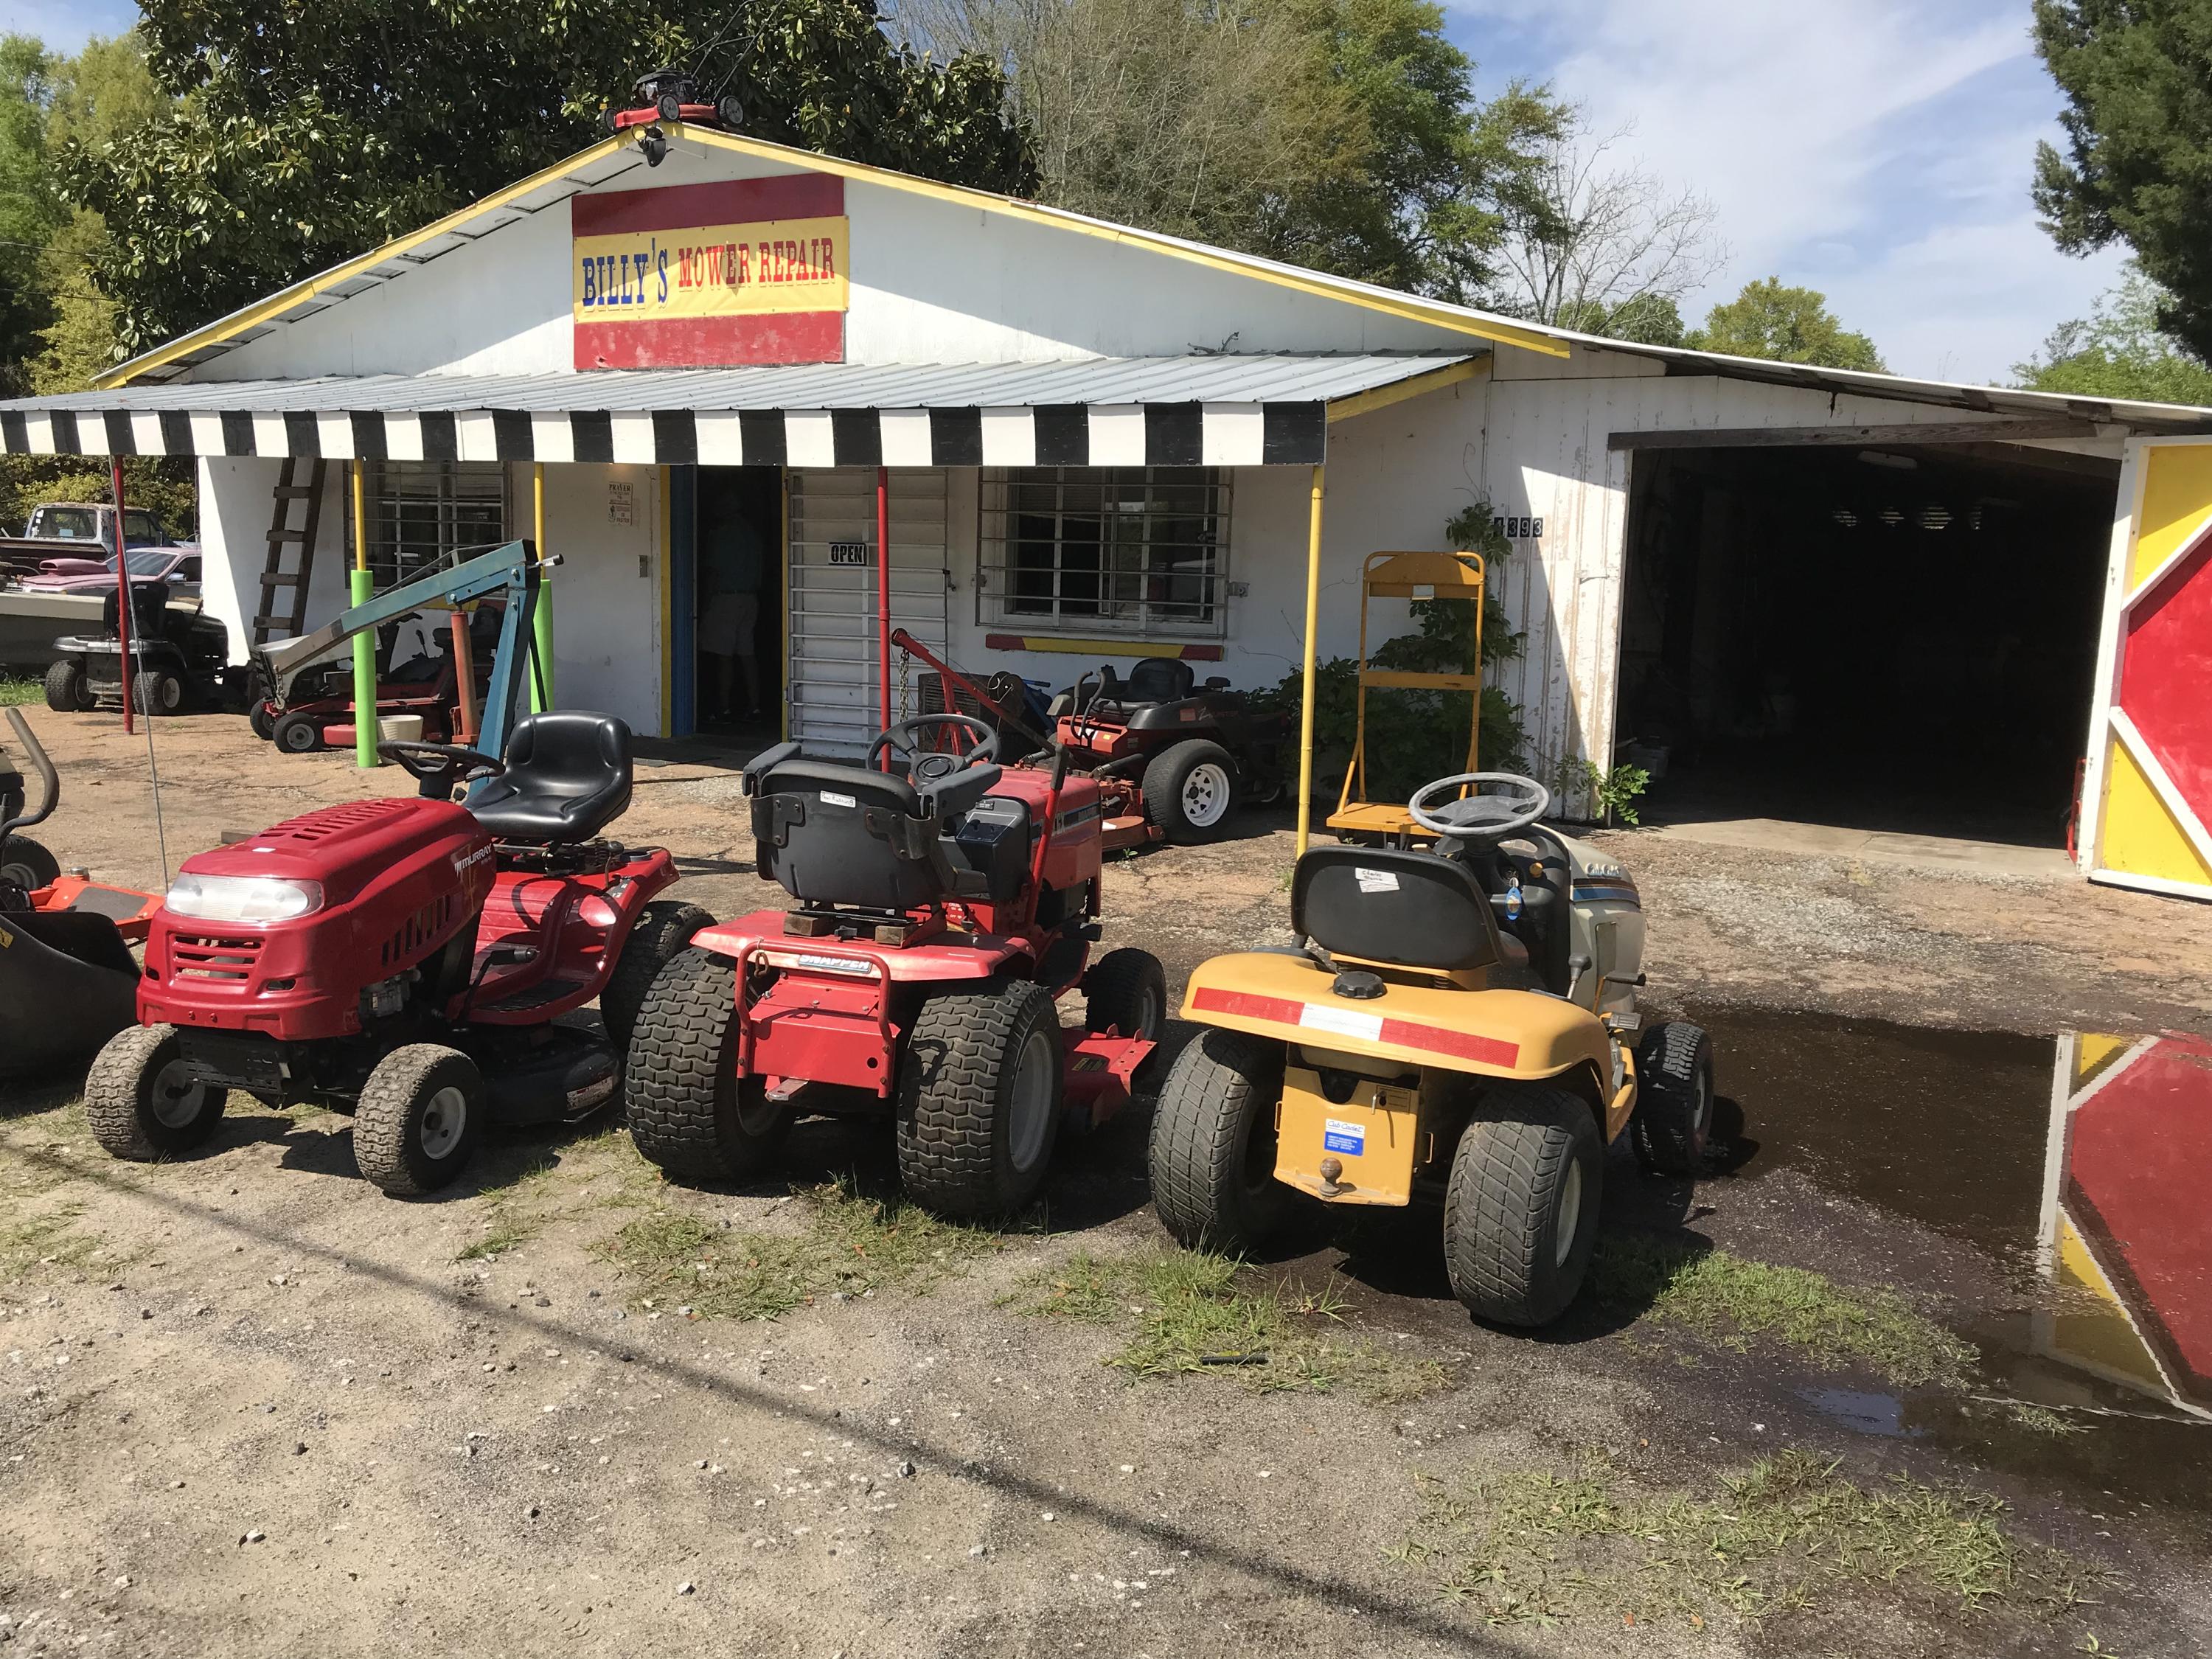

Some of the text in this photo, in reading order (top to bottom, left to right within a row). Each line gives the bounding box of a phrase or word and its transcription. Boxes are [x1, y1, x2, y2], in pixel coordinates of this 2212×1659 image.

[582, 237, 835, 309] BILLY'S MOWER REPAIR
[831, 544, 863, 563] OPEN
[462, 843, 492, 869] MURRAY
[799, 954, 871, 970] SNAPPER
[1327, 1120, 1364, 1133] Cub Cadet
